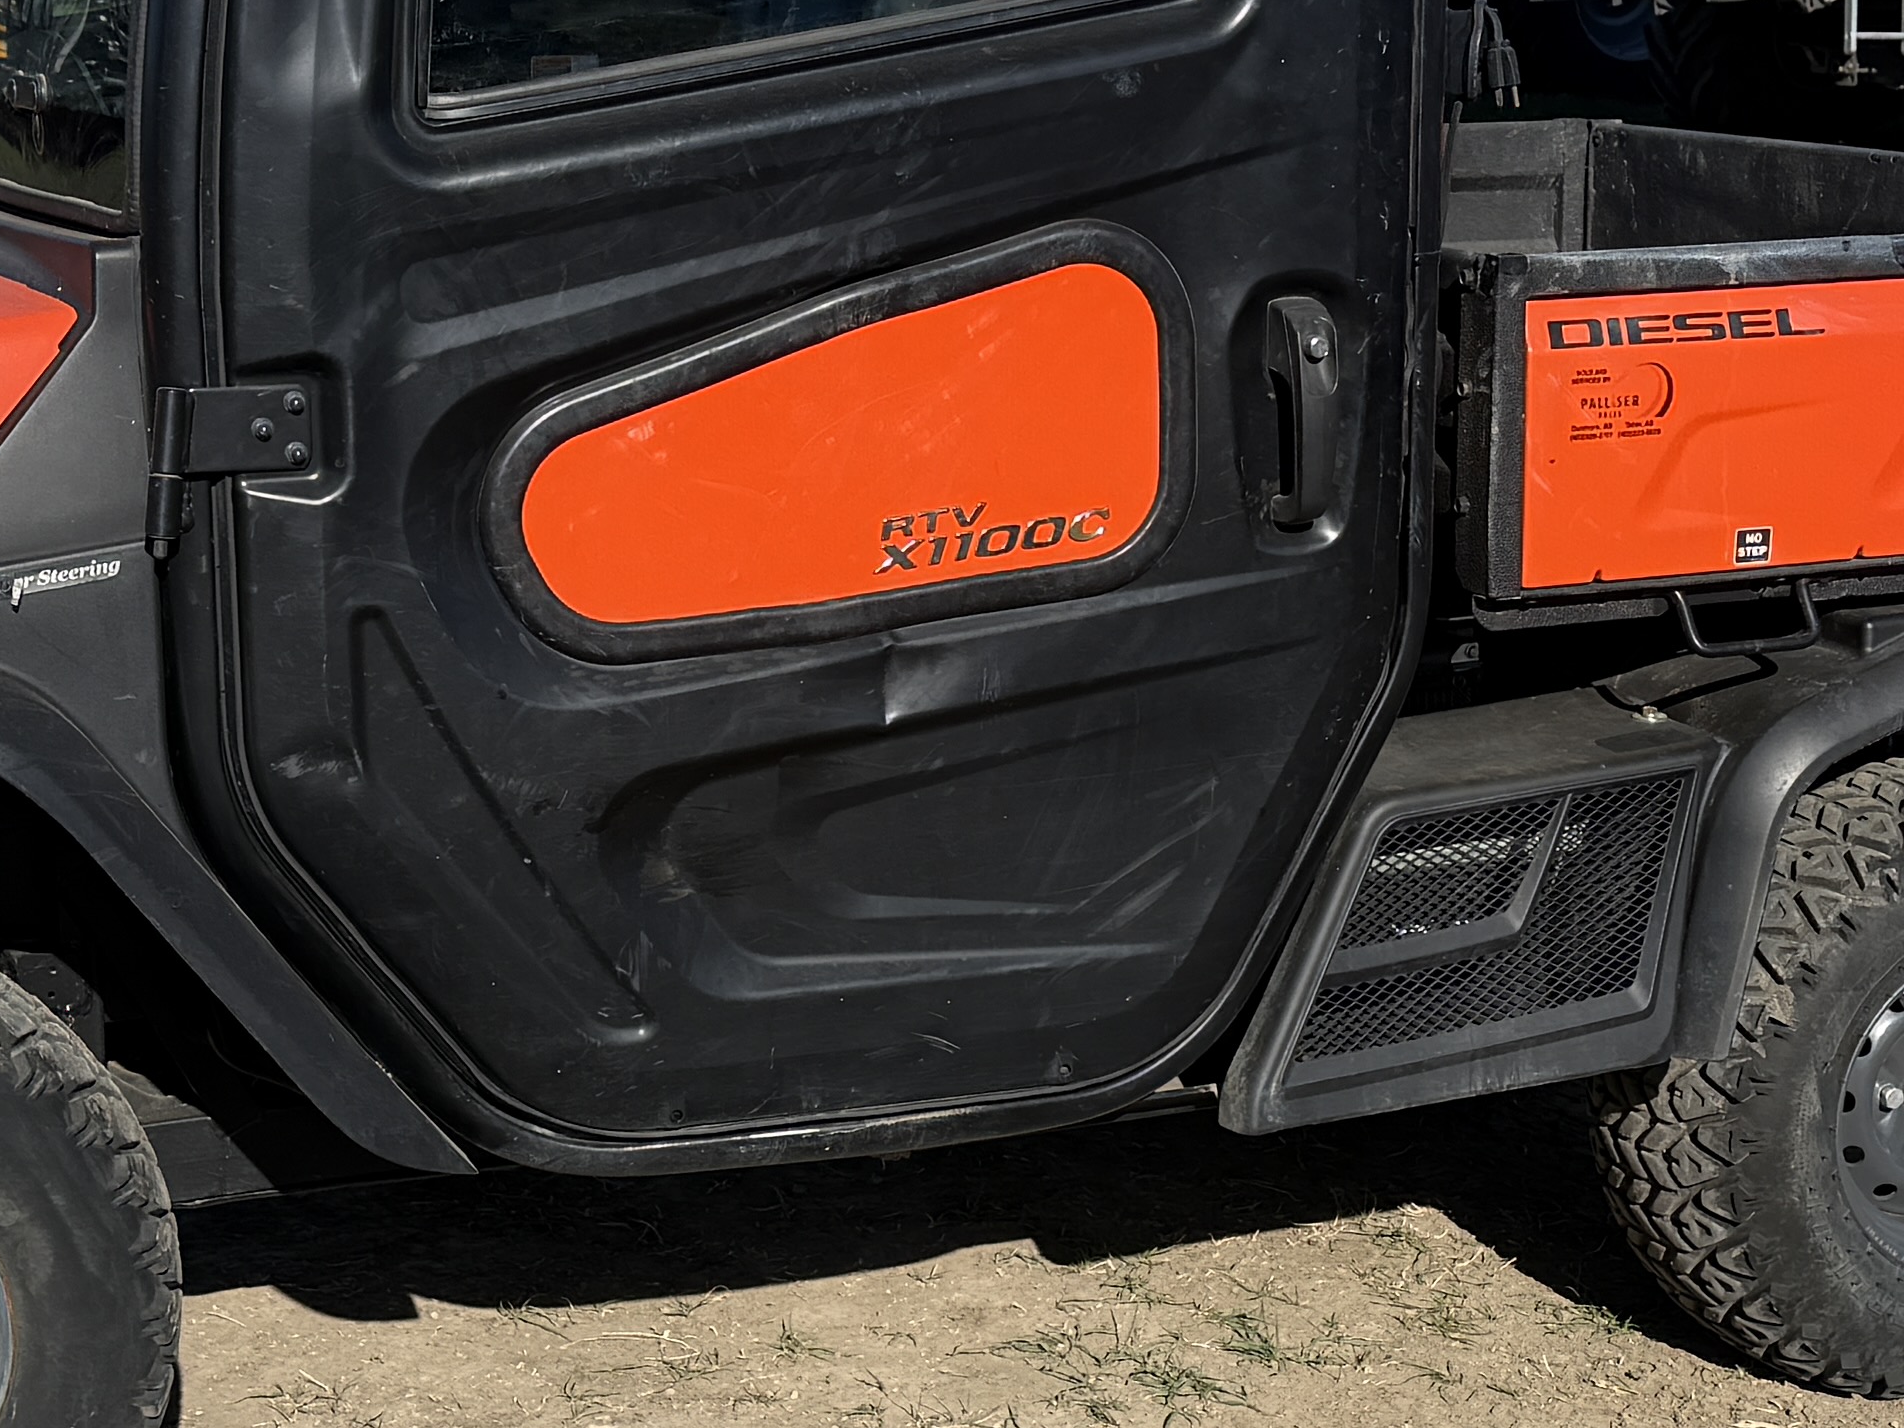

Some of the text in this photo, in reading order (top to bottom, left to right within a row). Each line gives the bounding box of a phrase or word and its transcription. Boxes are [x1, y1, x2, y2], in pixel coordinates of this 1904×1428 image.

[1548, 308, 1826, 349] DIESEL
[882, 502, 987, 541] RTV
[874, 507, 1110, 575] X1100C
[1738, 546, 1768, 557] STEP
[1746, 533, 1763, 544] NO
[37, 559, 121, 586] Steering
